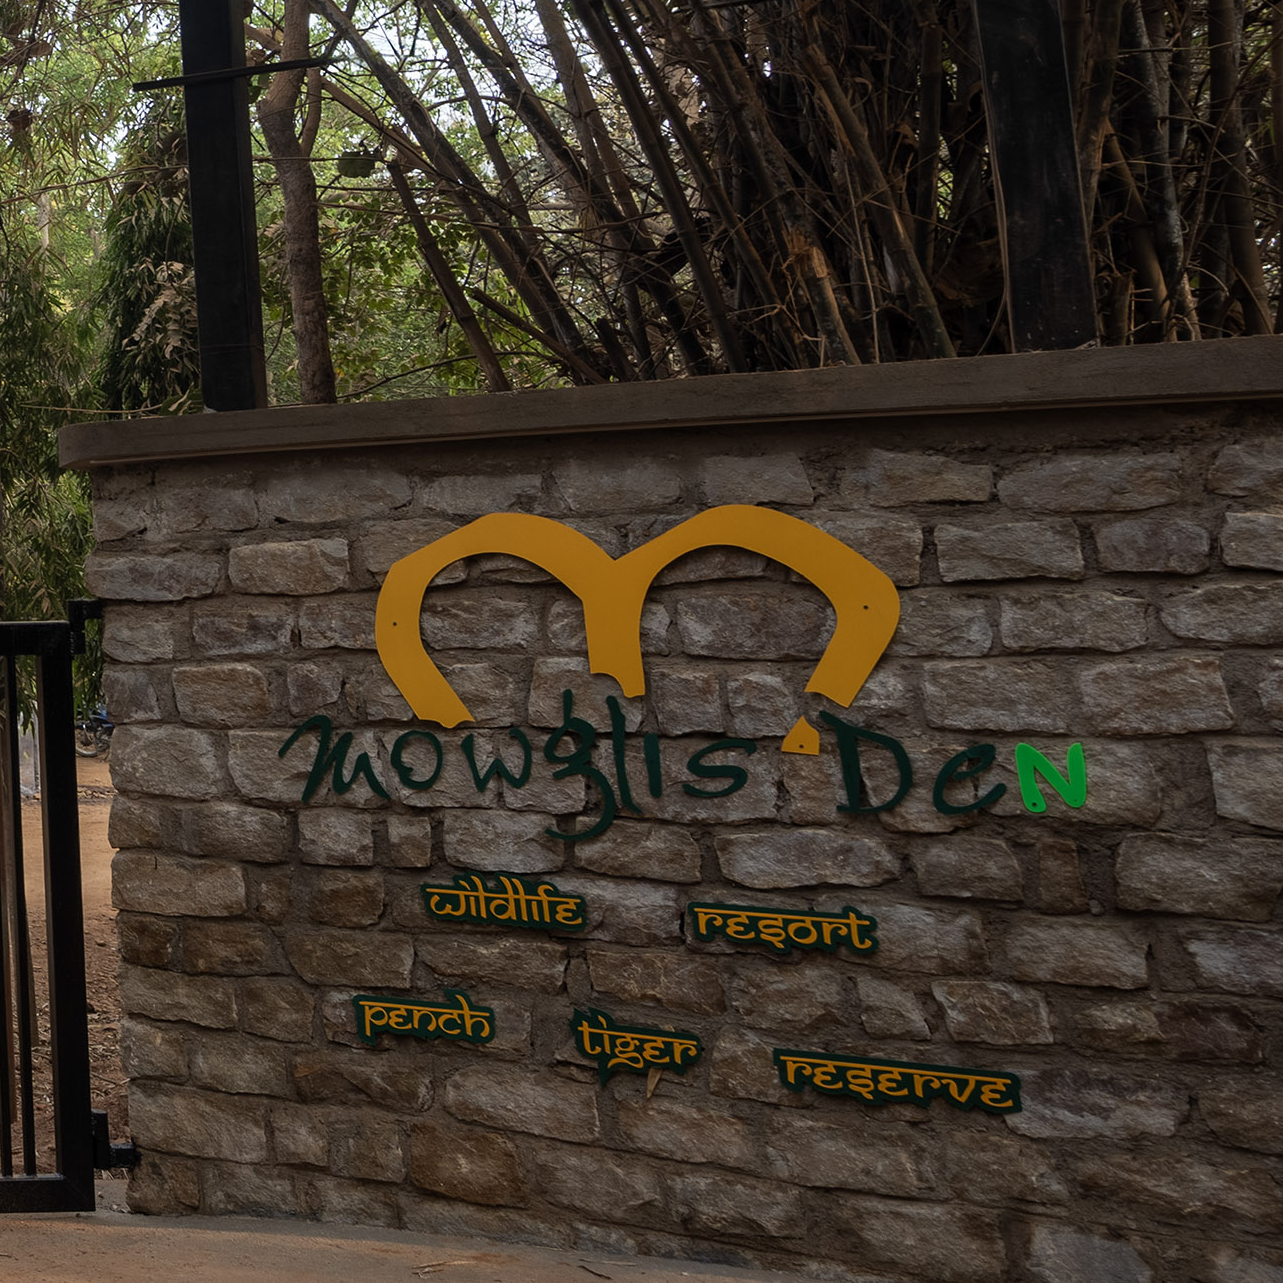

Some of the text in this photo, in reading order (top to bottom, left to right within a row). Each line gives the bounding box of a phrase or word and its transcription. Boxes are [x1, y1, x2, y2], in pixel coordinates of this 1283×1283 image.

[426, 875, 873, 951] wildlife resort
[359, 994, 1014, 1109] pench tiger reserve
